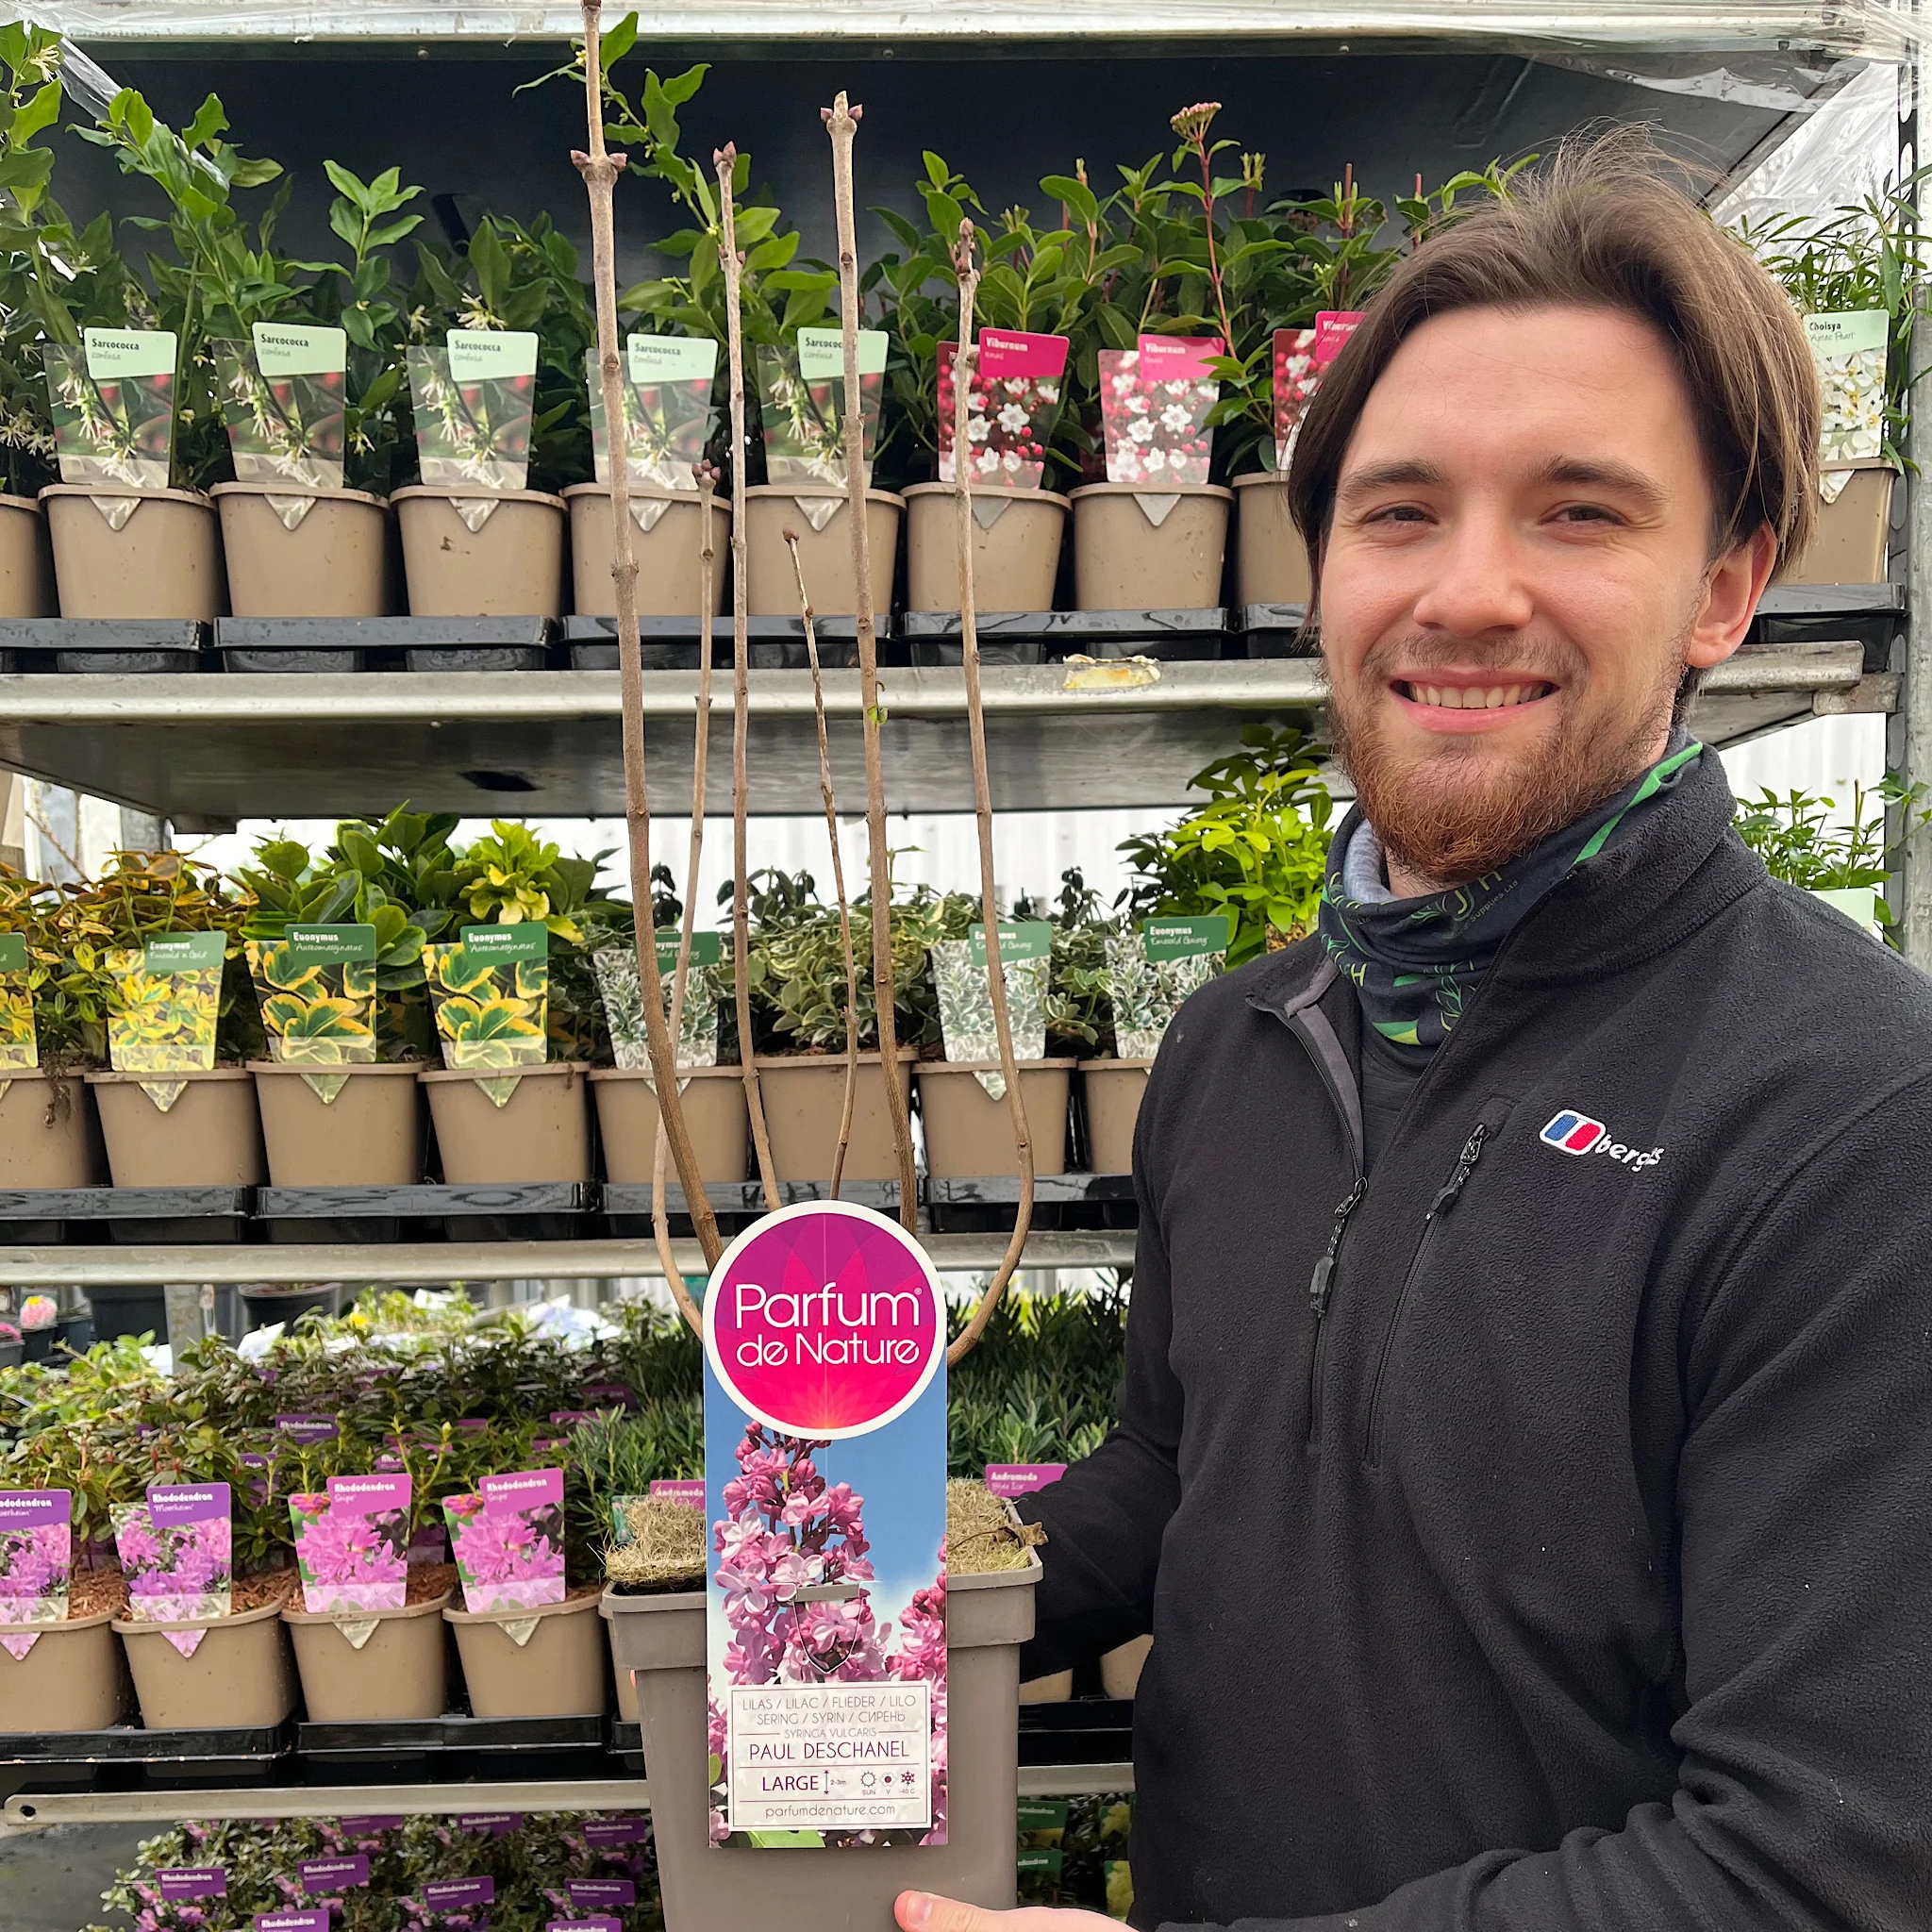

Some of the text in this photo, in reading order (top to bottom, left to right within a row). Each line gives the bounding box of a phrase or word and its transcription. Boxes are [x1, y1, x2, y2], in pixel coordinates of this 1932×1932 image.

[1809, 322, 1841, 332] Choisya
[92, 338, 140, 350] Sarcococca
[260, 333, 309, 347] Sarcococca
[455, 340, 501, 352] Sarcococca
[805, 337, 843, 349] Sarcococ
[635, 342, 681, 356] Sarcococca
[292, 931, 340, 943] Euonymus
[468, 932, 512, 944] Euonymus
[1149, 925, 1193, 938] Euonymus
[149, 941, 191, 951] Euonymus
[737, 1332, 920, 1367] de Nature
[991, 1472, 1038, 1482] Andromeda
[334, 1481, 396, 1493] Rhododendron
[486, 1477, 547, 1492] Rhododendron
[0, 1497, 53, 1508] ododendron
[152, 1491, 213, 1504] Rhododendron
[743, 1699, 773, 1710] LILAS
[786, 1697, 819, 1709] LILAC
[832, 1696, 875, 1708] FLIEDER
[890, 1695, 916, 1707] LILO
[758, 1713, 799, 1725] SERING
[812, 1712, 845, 1724] SYRIN
[784, 1727, 877, 1740] SYRINGA VULGARIS
[749, 1740, 910, 1760] PAUL DESCHANEL
[762, 1775, 820, 1791] LARGE
[765, 1804, 895, 1819] parfumdenature.com
